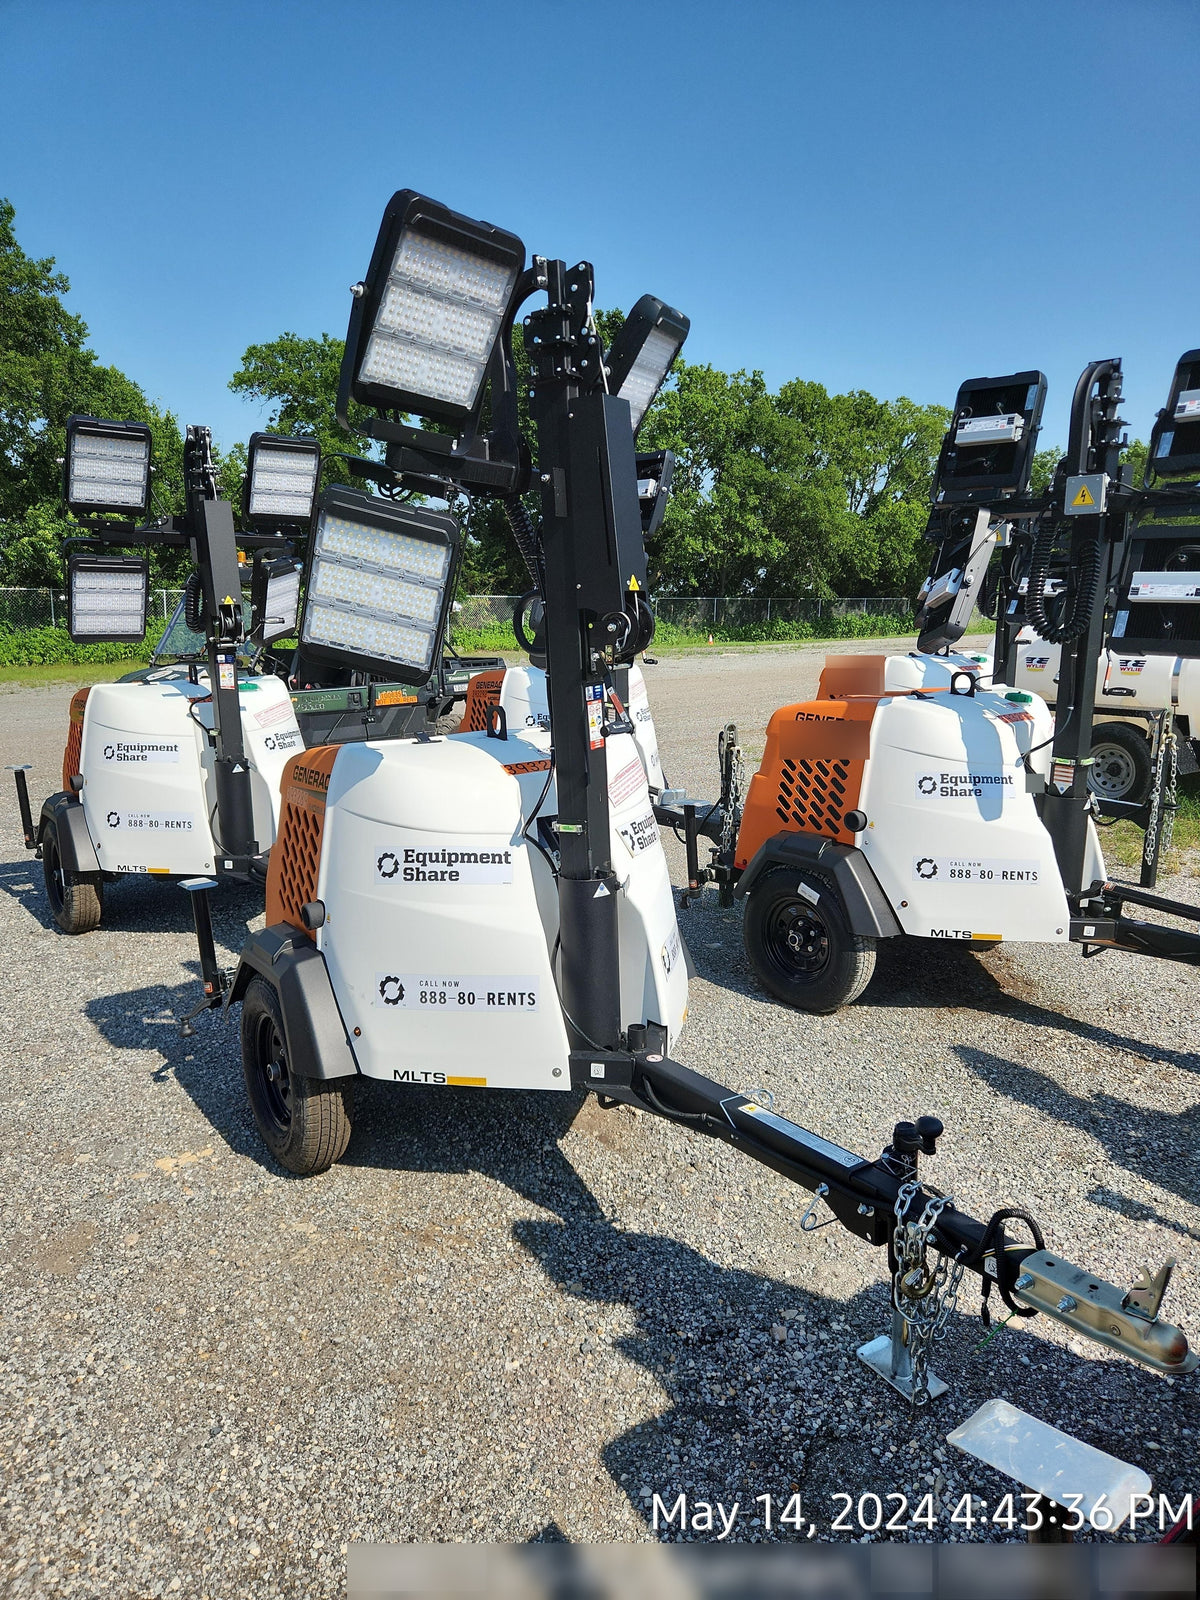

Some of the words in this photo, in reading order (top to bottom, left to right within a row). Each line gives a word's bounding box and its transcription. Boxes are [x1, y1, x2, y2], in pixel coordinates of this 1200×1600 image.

[116, 742, 179, 753] Equipment
[116, 752, 148, 762] Share
[293, 765, 331, 790] GENERAC
[939, 773, 1014, 787] Equipment
[939, 786, 983, 797] Share
[128, 819, 192, 829] 888-80-RENTS
[403, 848, 512, 867] Equipment
[117, 864, 147, 873] MLTS
[403, 866, 460, 882] Share
[949, 868, 1038, 881] 888-80-RENTS
[930, 928, 972, 939] MLTS
[419, 980, 439, 988] CALL
[442, 980, 460, 988] NOW
[419, 990, 536, 1006] 888-80-RENTS
[393, 1069, 447, 1084] MLTS
